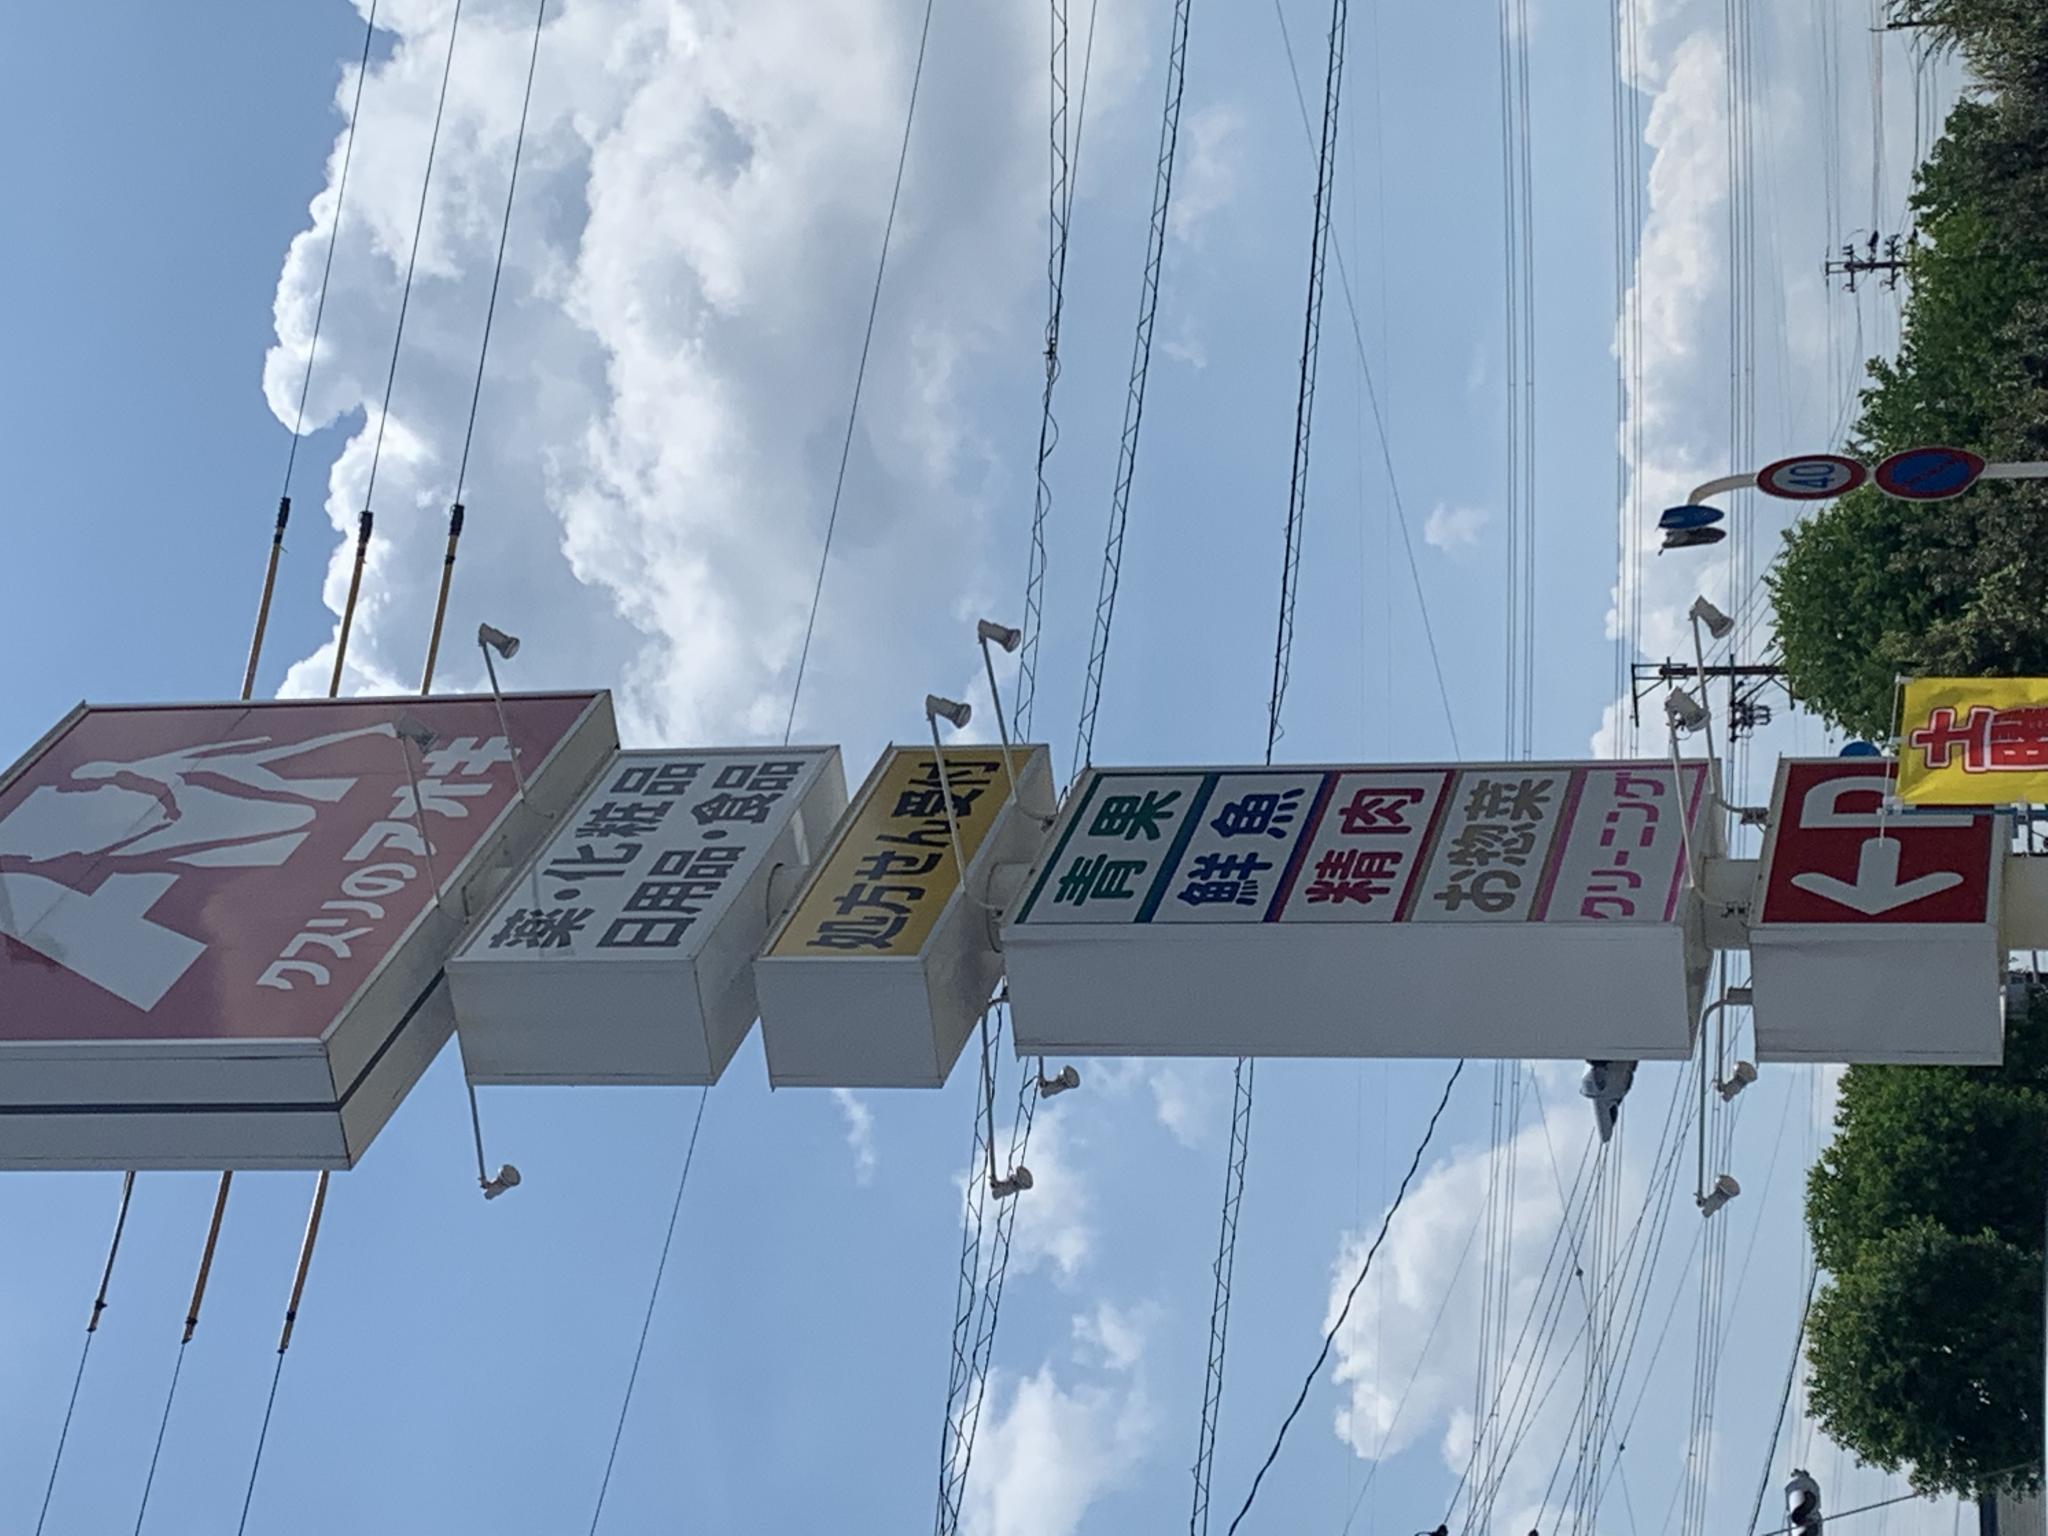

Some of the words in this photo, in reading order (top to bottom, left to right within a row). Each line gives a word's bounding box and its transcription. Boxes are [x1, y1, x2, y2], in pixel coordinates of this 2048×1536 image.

[1789, 463, 1834, 488] 40
[256, 737, 518, 990] クスリのアオキ
[490, 763, 705, 949] 薬・化粧品
[597, 761, 804, 949] 日用品・食品
[808, 760, 1000, 950] 処方せん受付
[1053, 790, 1182, 906] 青果
[1176, 788, 1305, 906] 鮮魚
[1305, 787, 1423, 905] 精肉
[1434, 780, 1553, 911] お惣菜
[1581, 773, 1664, 918] クリーニング
[1799, 776, 1973, 827] P
